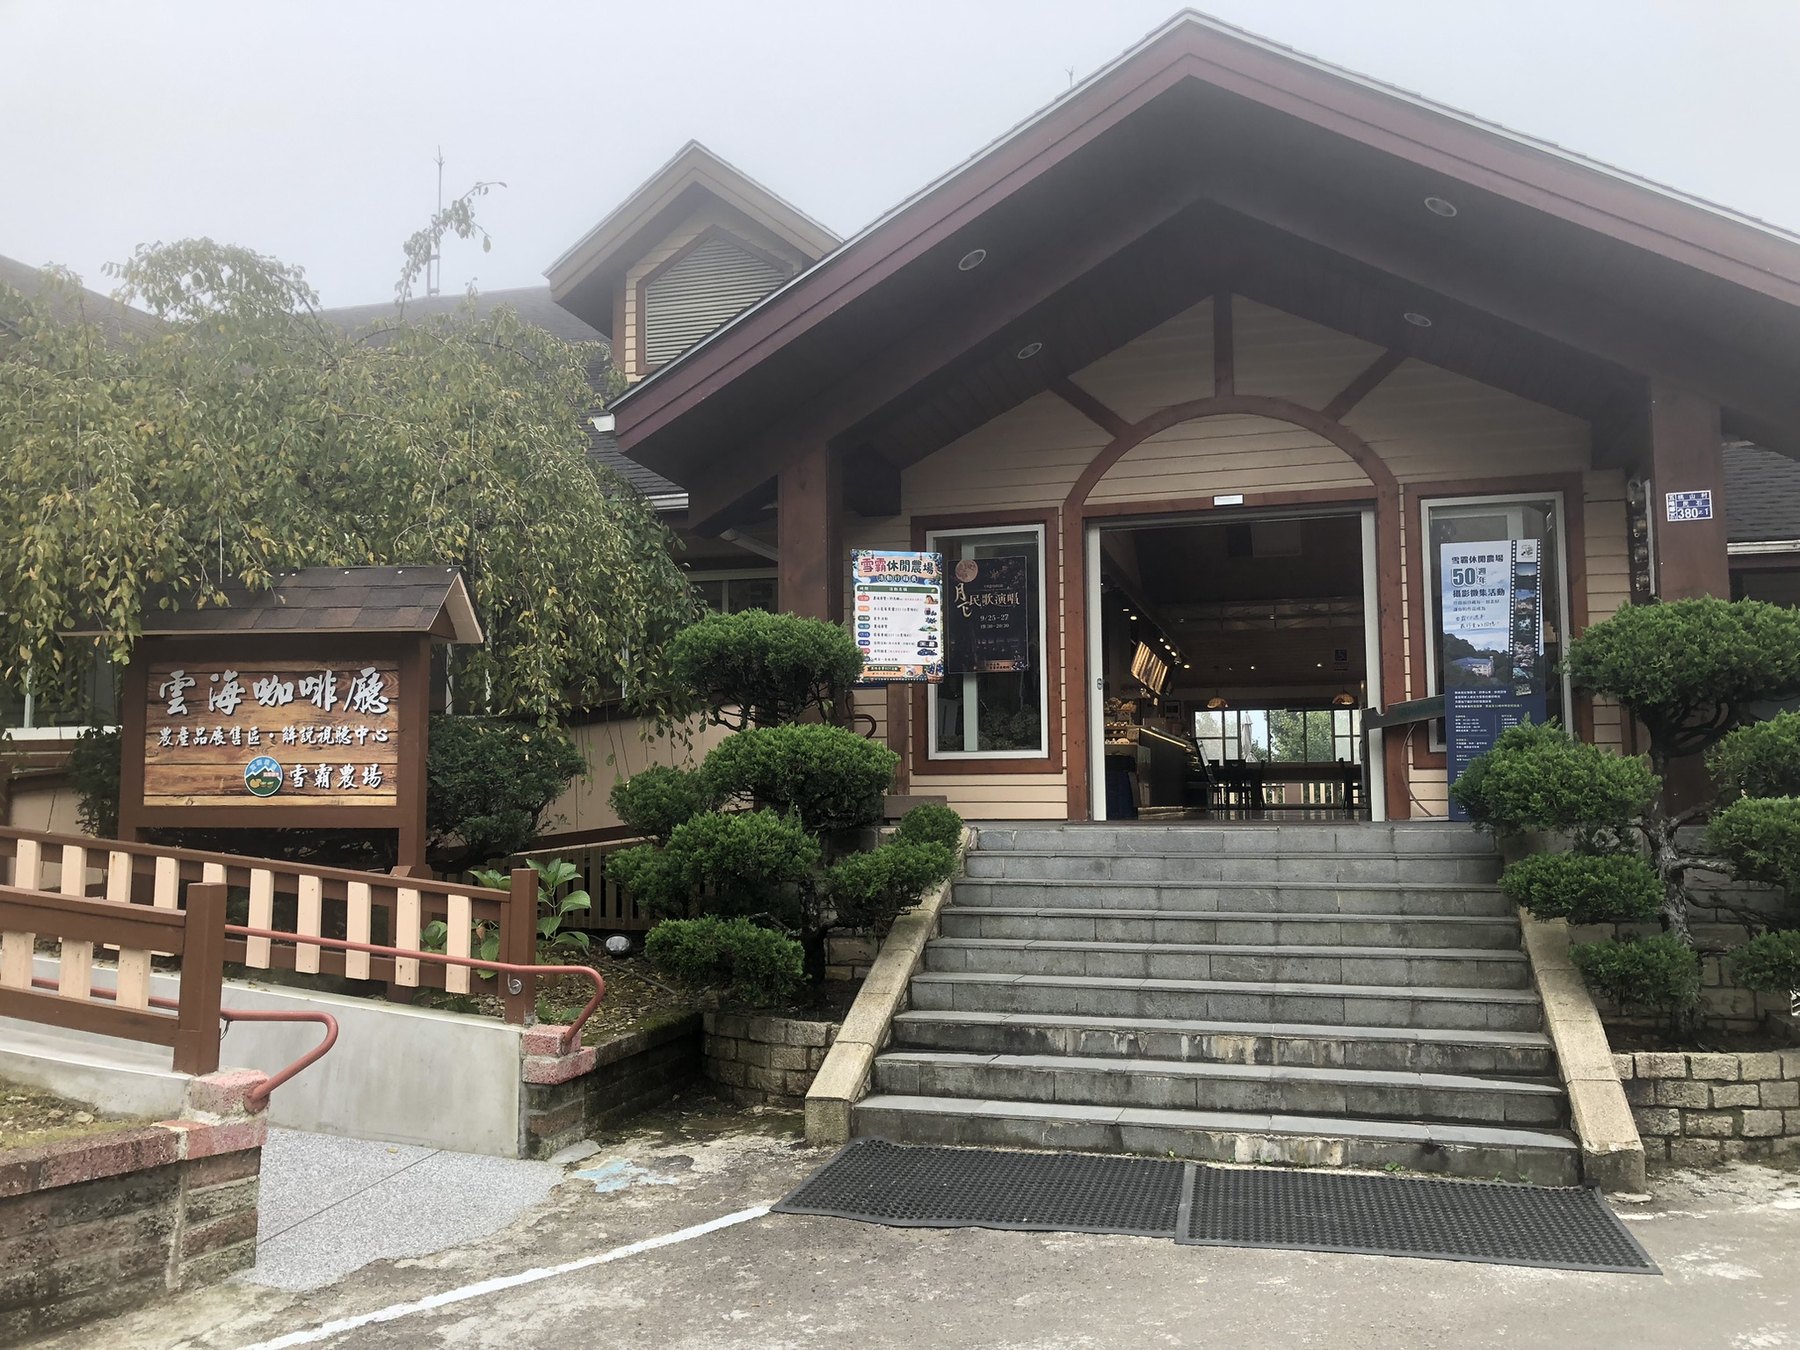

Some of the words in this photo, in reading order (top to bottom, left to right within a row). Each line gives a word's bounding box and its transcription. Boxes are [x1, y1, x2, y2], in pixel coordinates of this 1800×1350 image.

[1452, 567, 1476, 586] 50
[159, 667, 390, 716] 雲海咖啡廳
[289, 763, 384, 790] 雪霸農場
